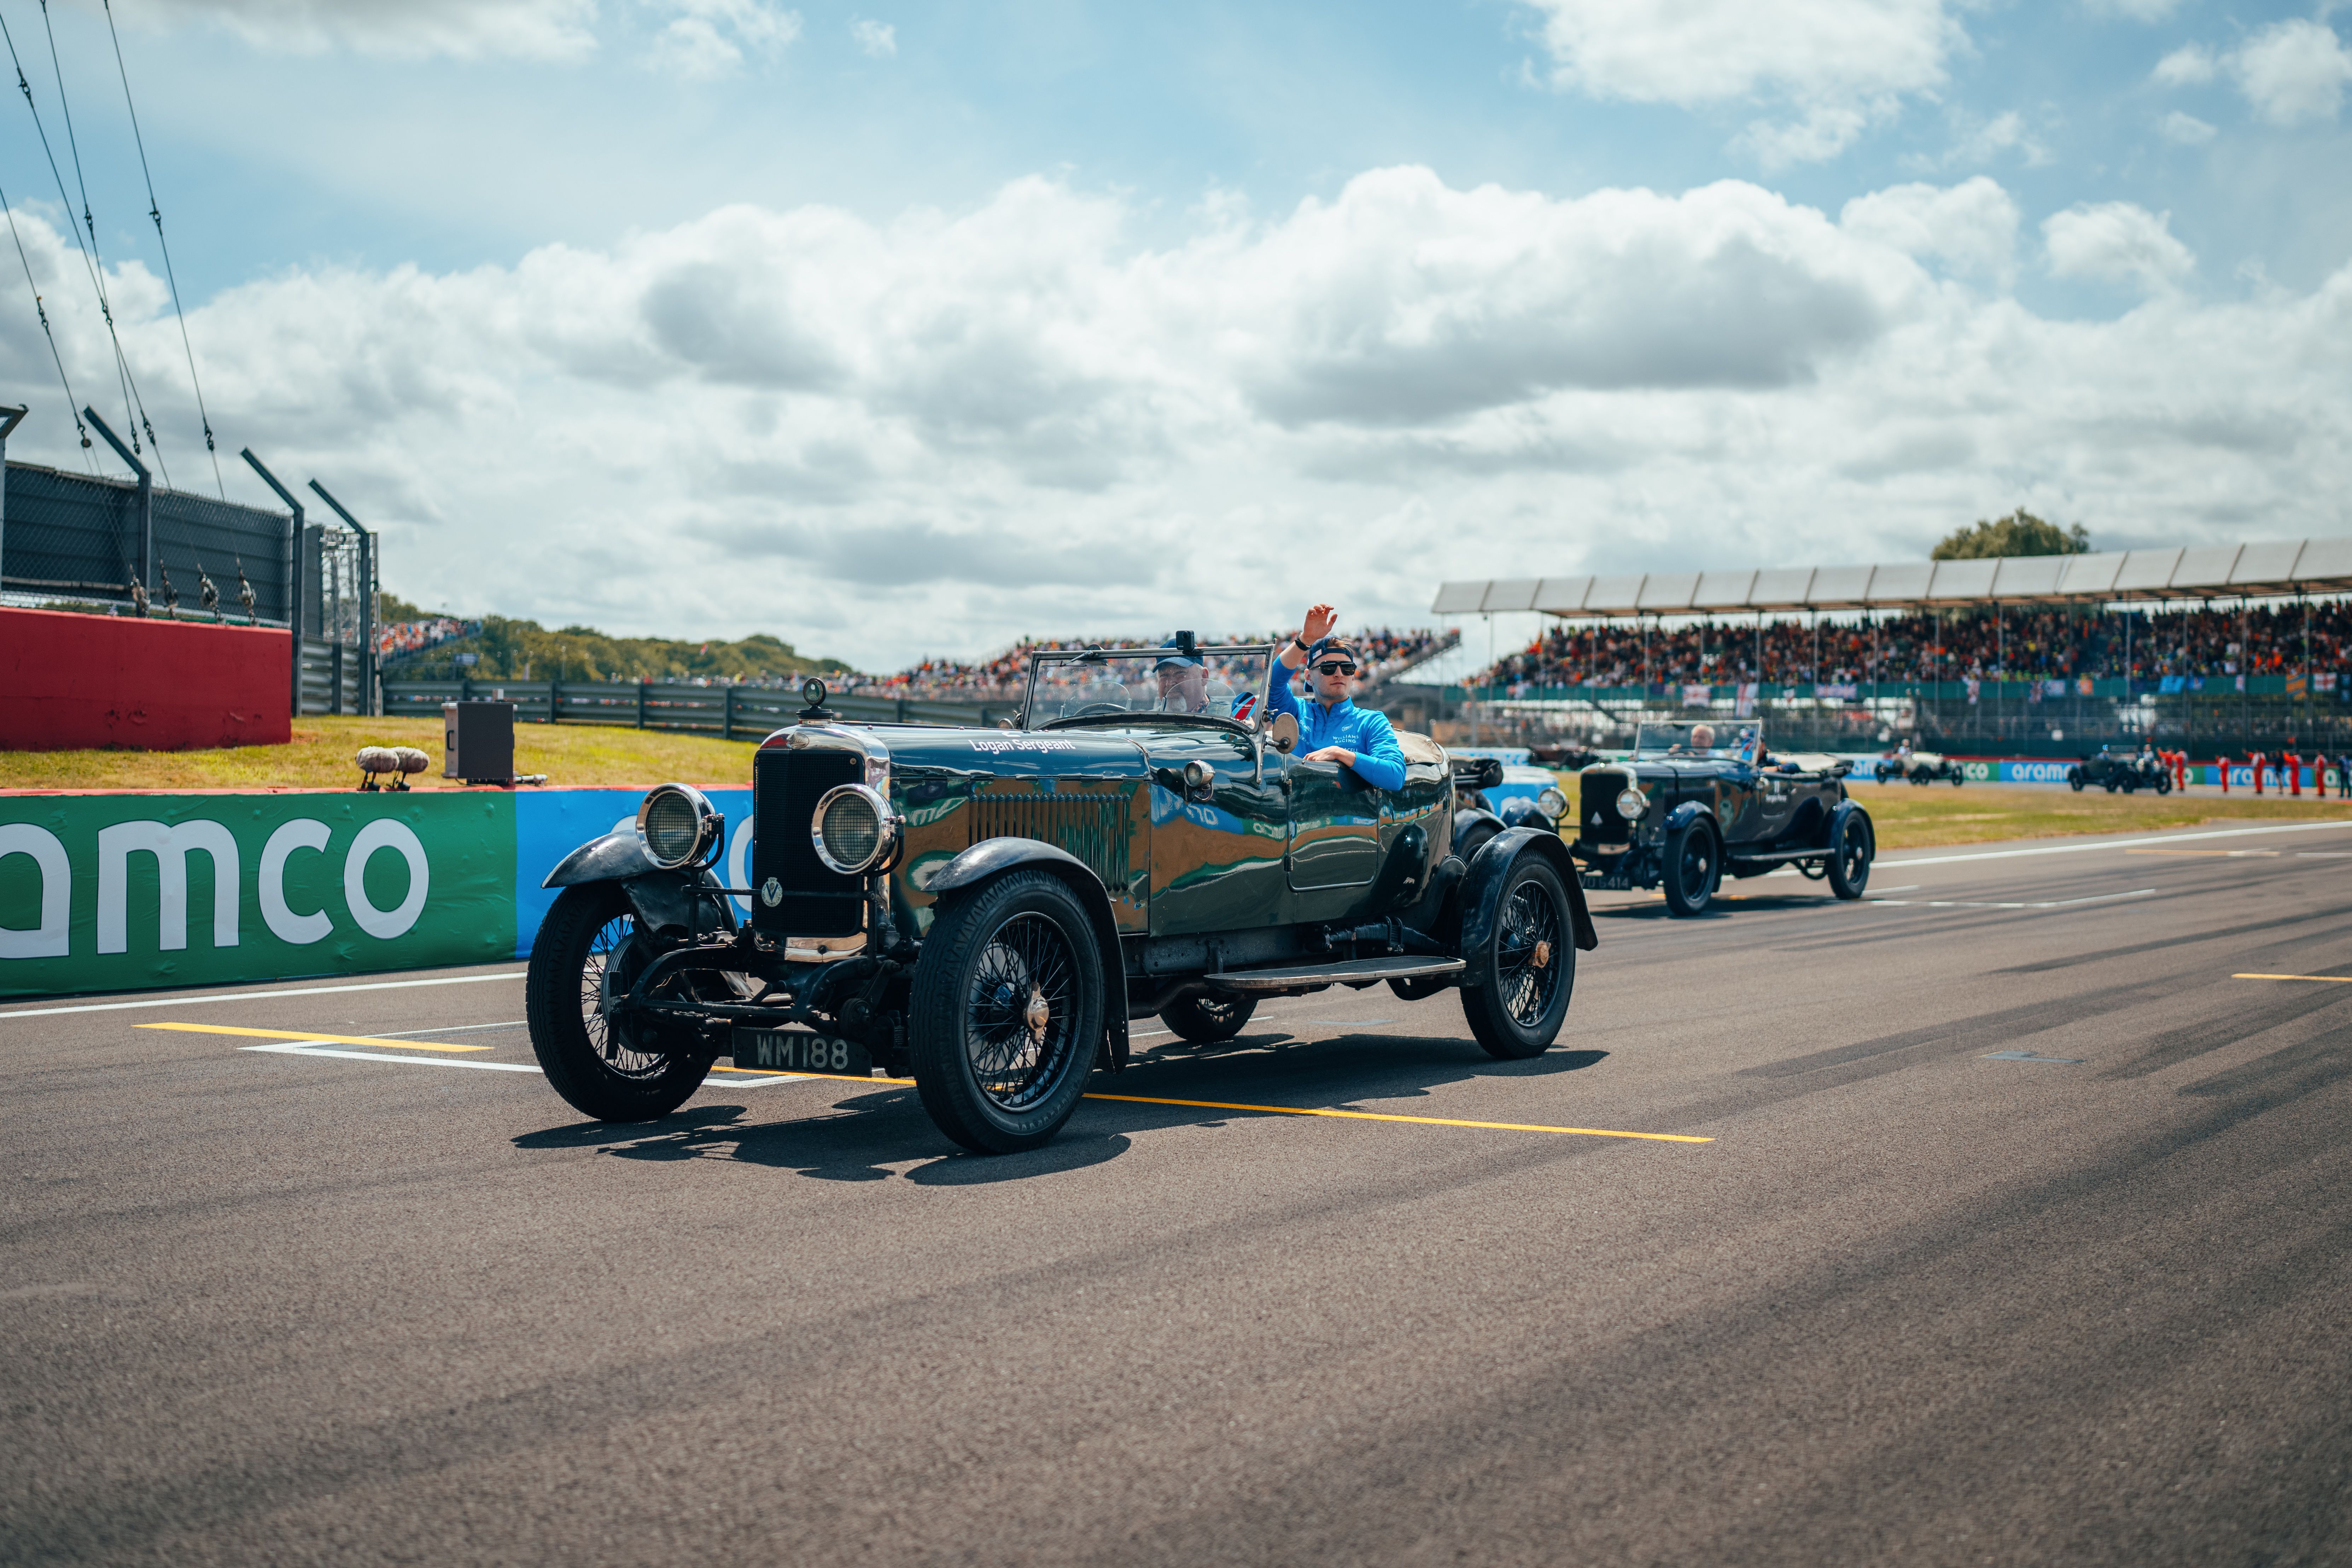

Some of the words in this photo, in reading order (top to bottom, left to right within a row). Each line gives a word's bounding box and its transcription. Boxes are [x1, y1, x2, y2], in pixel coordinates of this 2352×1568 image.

[968, 739, 1014, 754] Logan
[1012, 739, 1076, 753] Sergeant
[0, 818, 430, 960] amco
[757, 1034, 794, 1066] WM
[803, 1037, 848, 1069] 188
